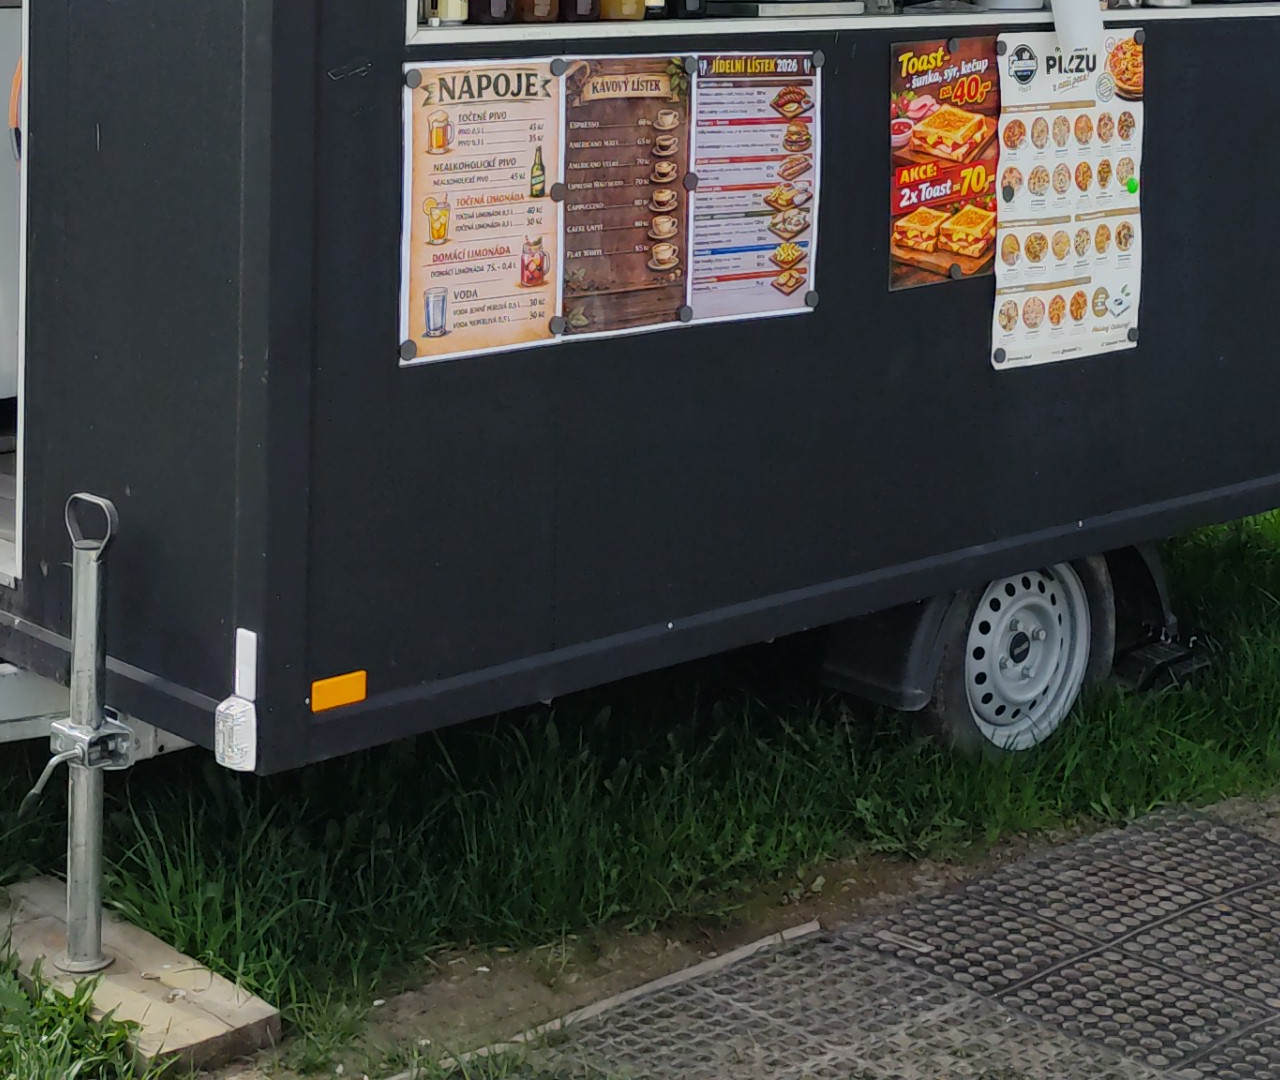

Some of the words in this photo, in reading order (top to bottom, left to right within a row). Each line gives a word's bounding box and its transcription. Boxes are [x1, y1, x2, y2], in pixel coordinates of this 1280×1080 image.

[710, 56, 746, 74] JÍDELNÍ
[747, 56, 776, 73] LÍSTEK
[776, 58, 798, 72] 2026
[960, 59, 989, 75] kečup
[438, 70, 538, 102] NÁPOJE
[592, 78, 630, 94] KÁVOVÝ
[631, 78, 661, 91] LÍSTEK
[489, 111, 507, 120] PIVO
[499, 157, 517, 167] PIVO
[900, 163, 937, 184] AKCE:
[900, 188, 919, 208] 2x
[918, 179, 952, 202] Toast
[432, 248, 466, 263] DOMÁCÍ
[467, 245, 511, 258] LIMONÁDA
[453, 289, 478, 300] VODA
